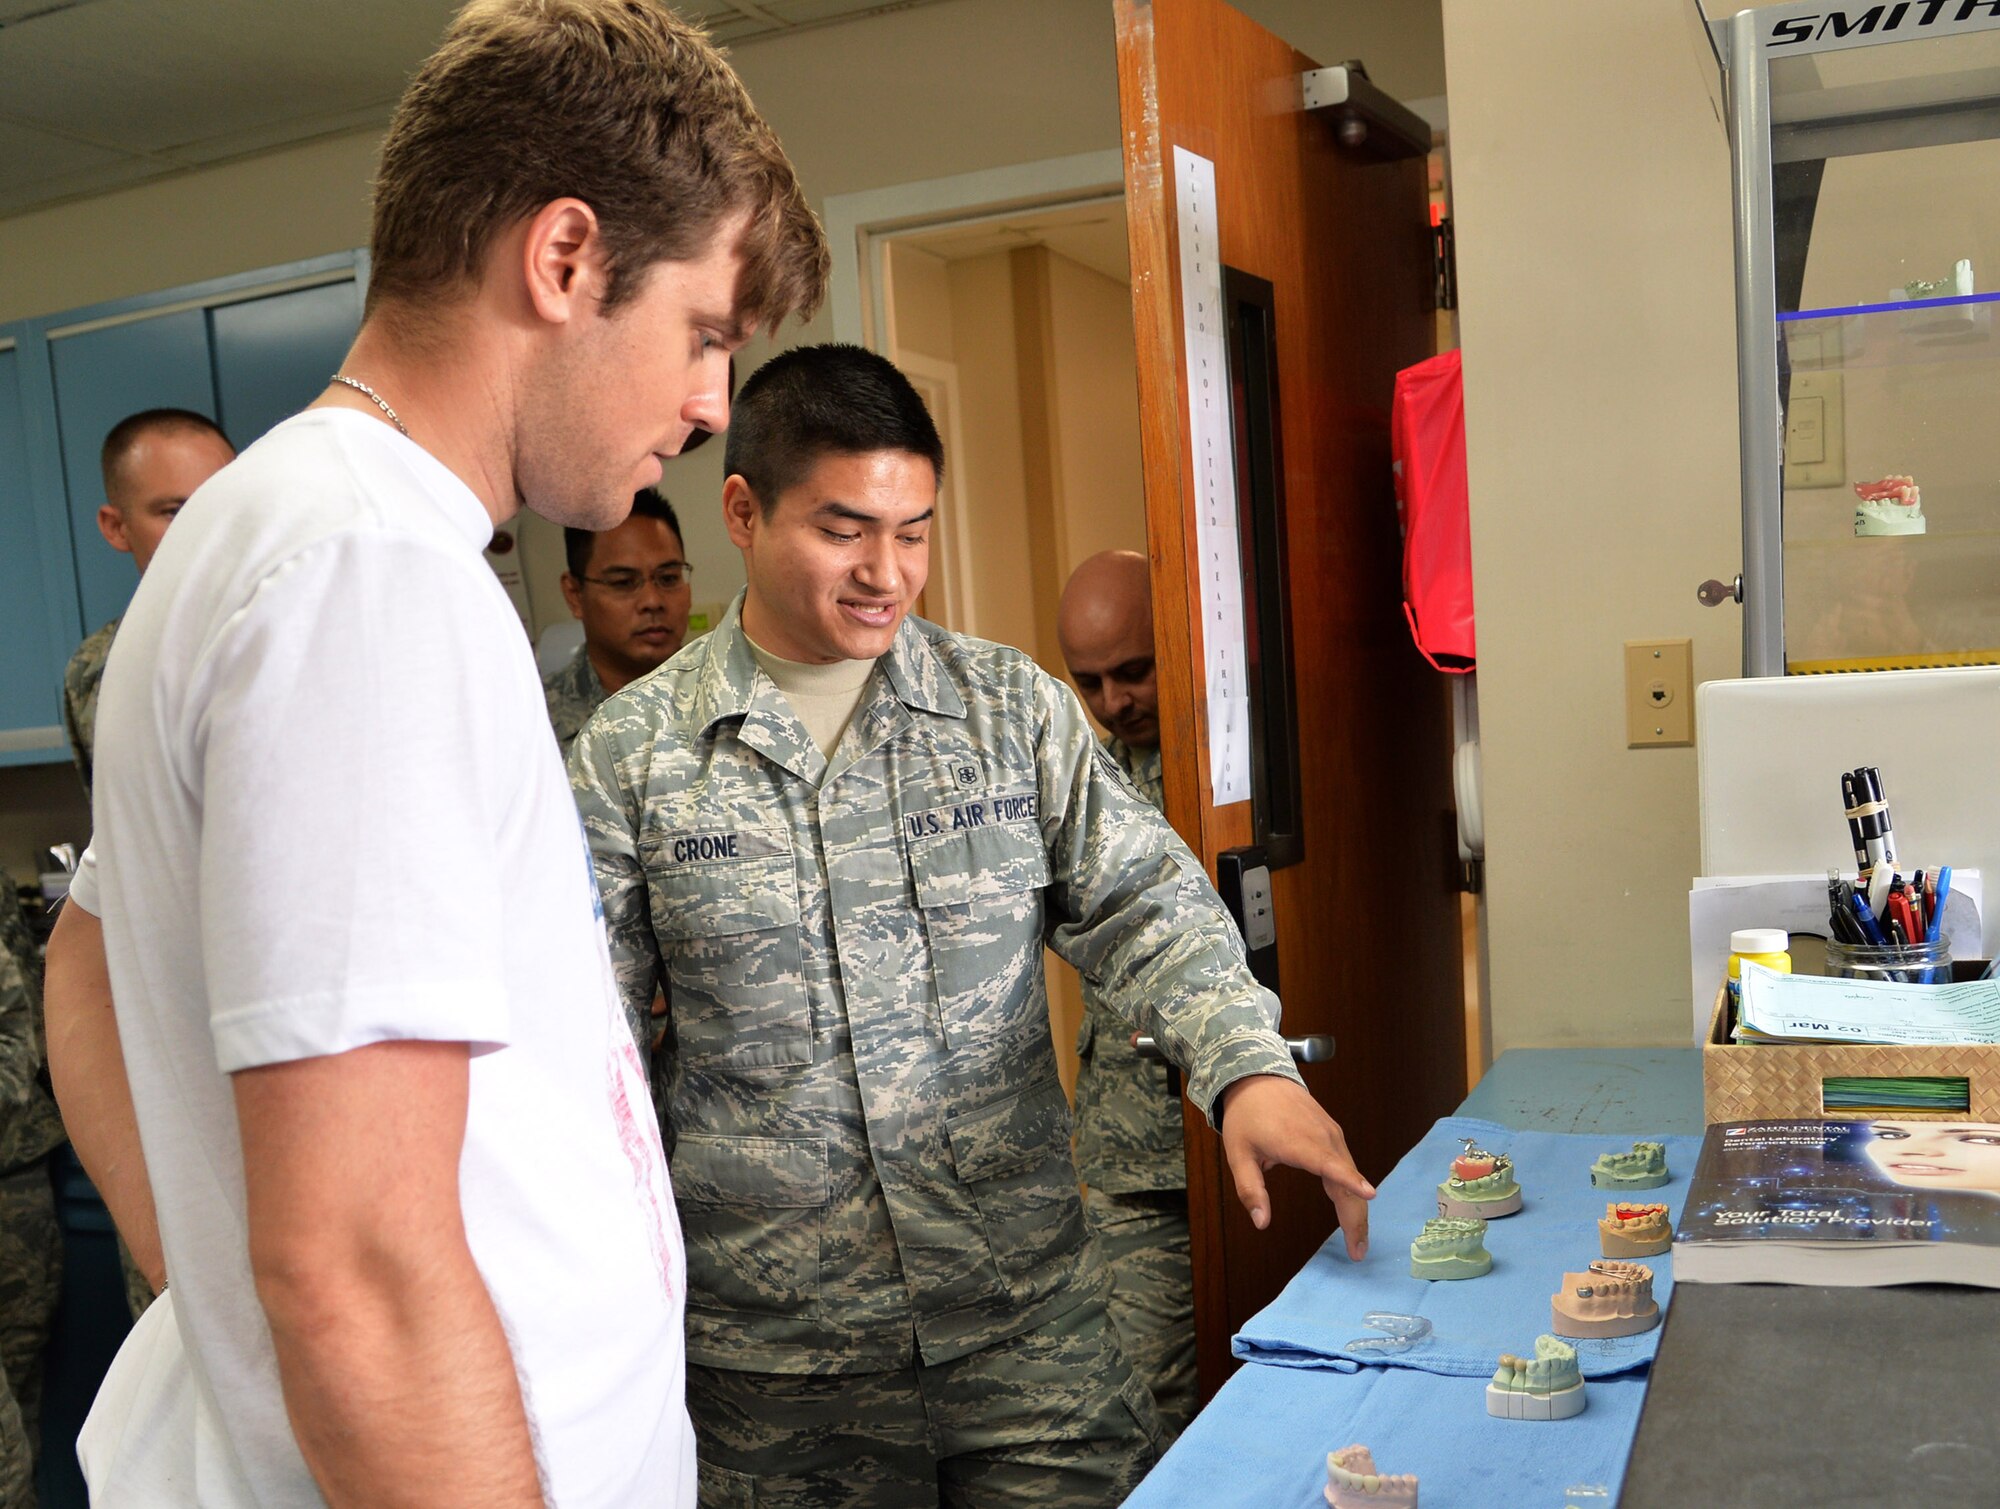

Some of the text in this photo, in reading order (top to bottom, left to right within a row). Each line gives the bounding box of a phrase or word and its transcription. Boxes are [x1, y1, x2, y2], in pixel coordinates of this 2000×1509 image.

[1190, 163, 1201, 273] PLEASE
[1198, 302, 1205, 333] DO
[1207, 438, 1217, 526] STAND
[1214, 553, 1223, 621] NEAR
[910, 796, 1035, 837] U.S. AIR FORCE
[674, 834, 739, 863] CRONE
[1788, 1022, 1830, 1031] Mar
[1768, 1135, 1837, 1143] Laboratory
[1715, 1209, 1841, 1219] Your Total
[1713, 1215, 1938, 1227] Solution Provider
